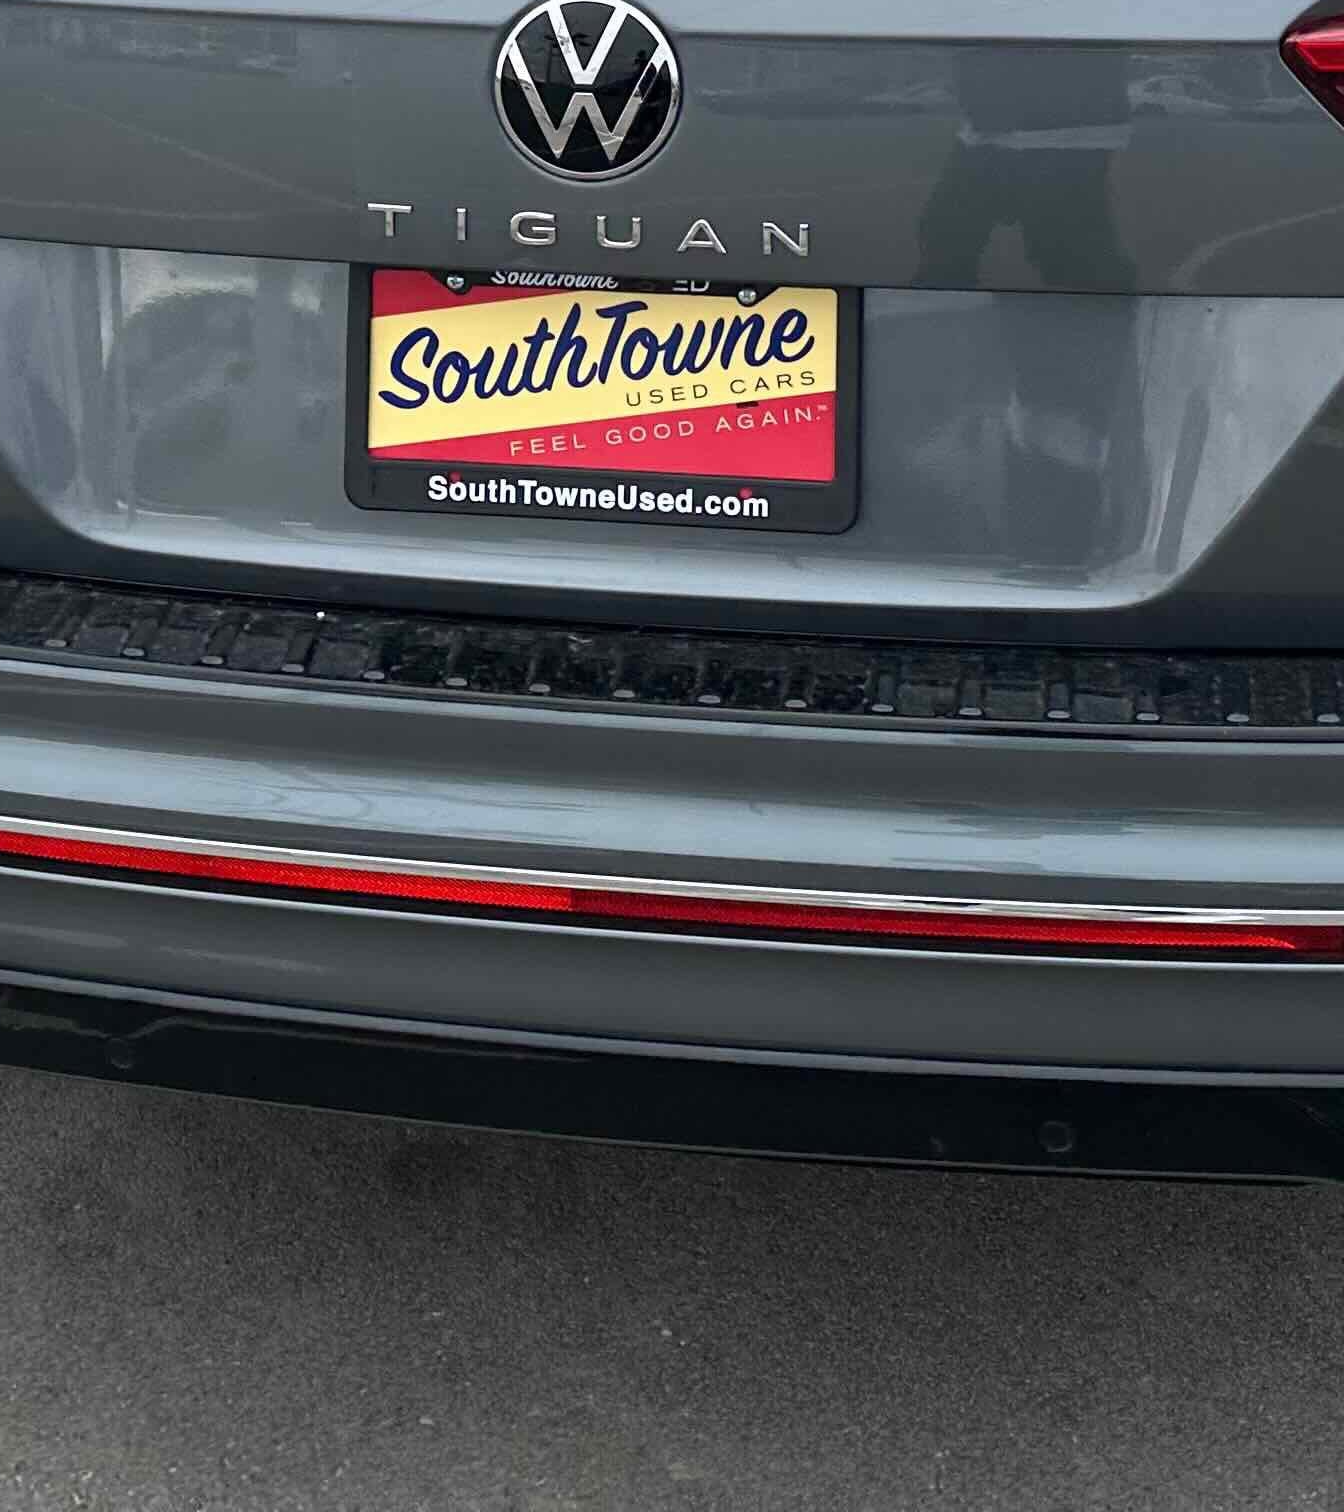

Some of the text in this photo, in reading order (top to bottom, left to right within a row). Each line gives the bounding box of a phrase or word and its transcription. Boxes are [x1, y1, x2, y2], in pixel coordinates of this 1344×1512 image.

[367, 202, 811, 257] TIGUAN
[378, 300, 815, 410] SouthTowne
[625, 371, 816, 407] USED CARS
[509, 433, 587, 457] FEEL
[605, 420, 695, 446] GOOD
[428, 474, 769, 517] SouthTowneUsed.com
